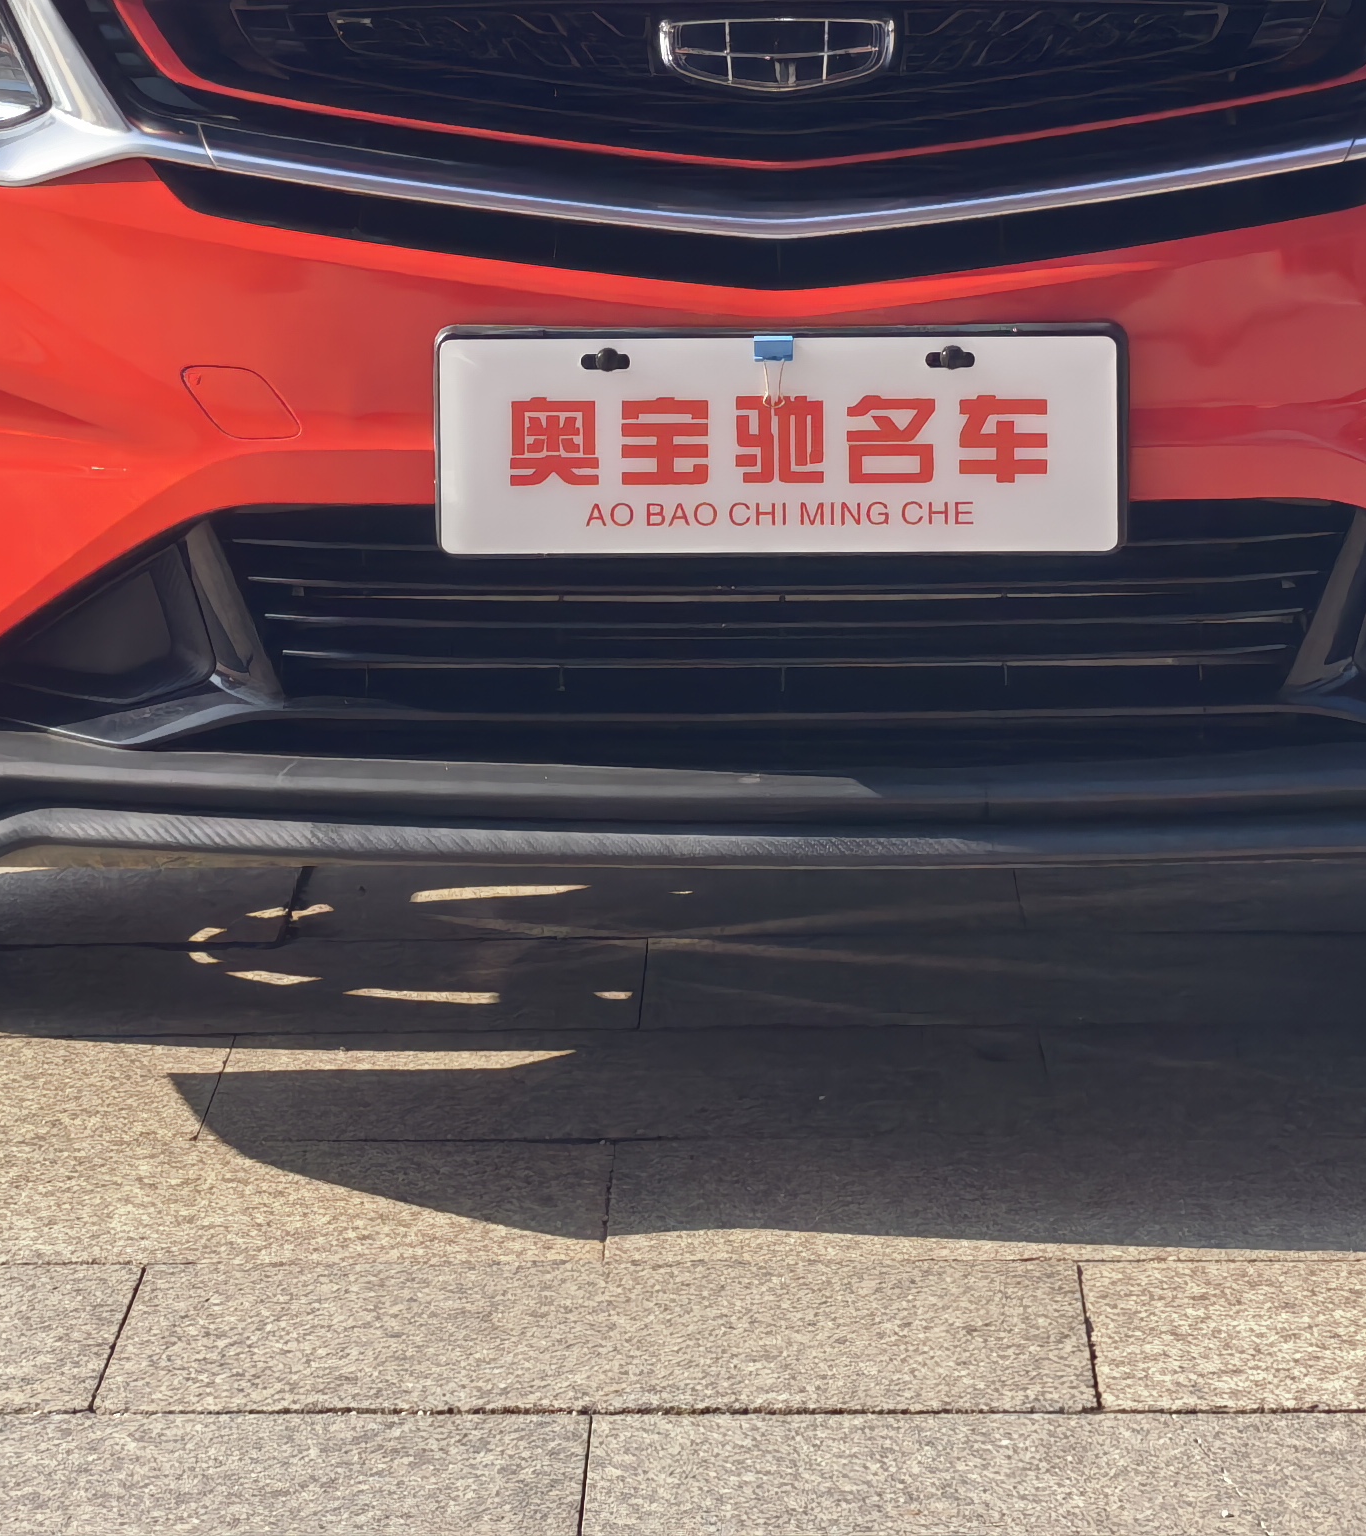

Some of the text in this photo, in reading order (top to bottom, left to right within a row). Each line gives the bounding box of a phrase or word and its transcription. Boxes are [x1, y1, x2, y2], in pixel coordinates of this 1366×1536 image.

[509, 394, 1049, 487] 奥宝驰名车
[585, 500, 974, 528] AO BAO CHI MING CHE
